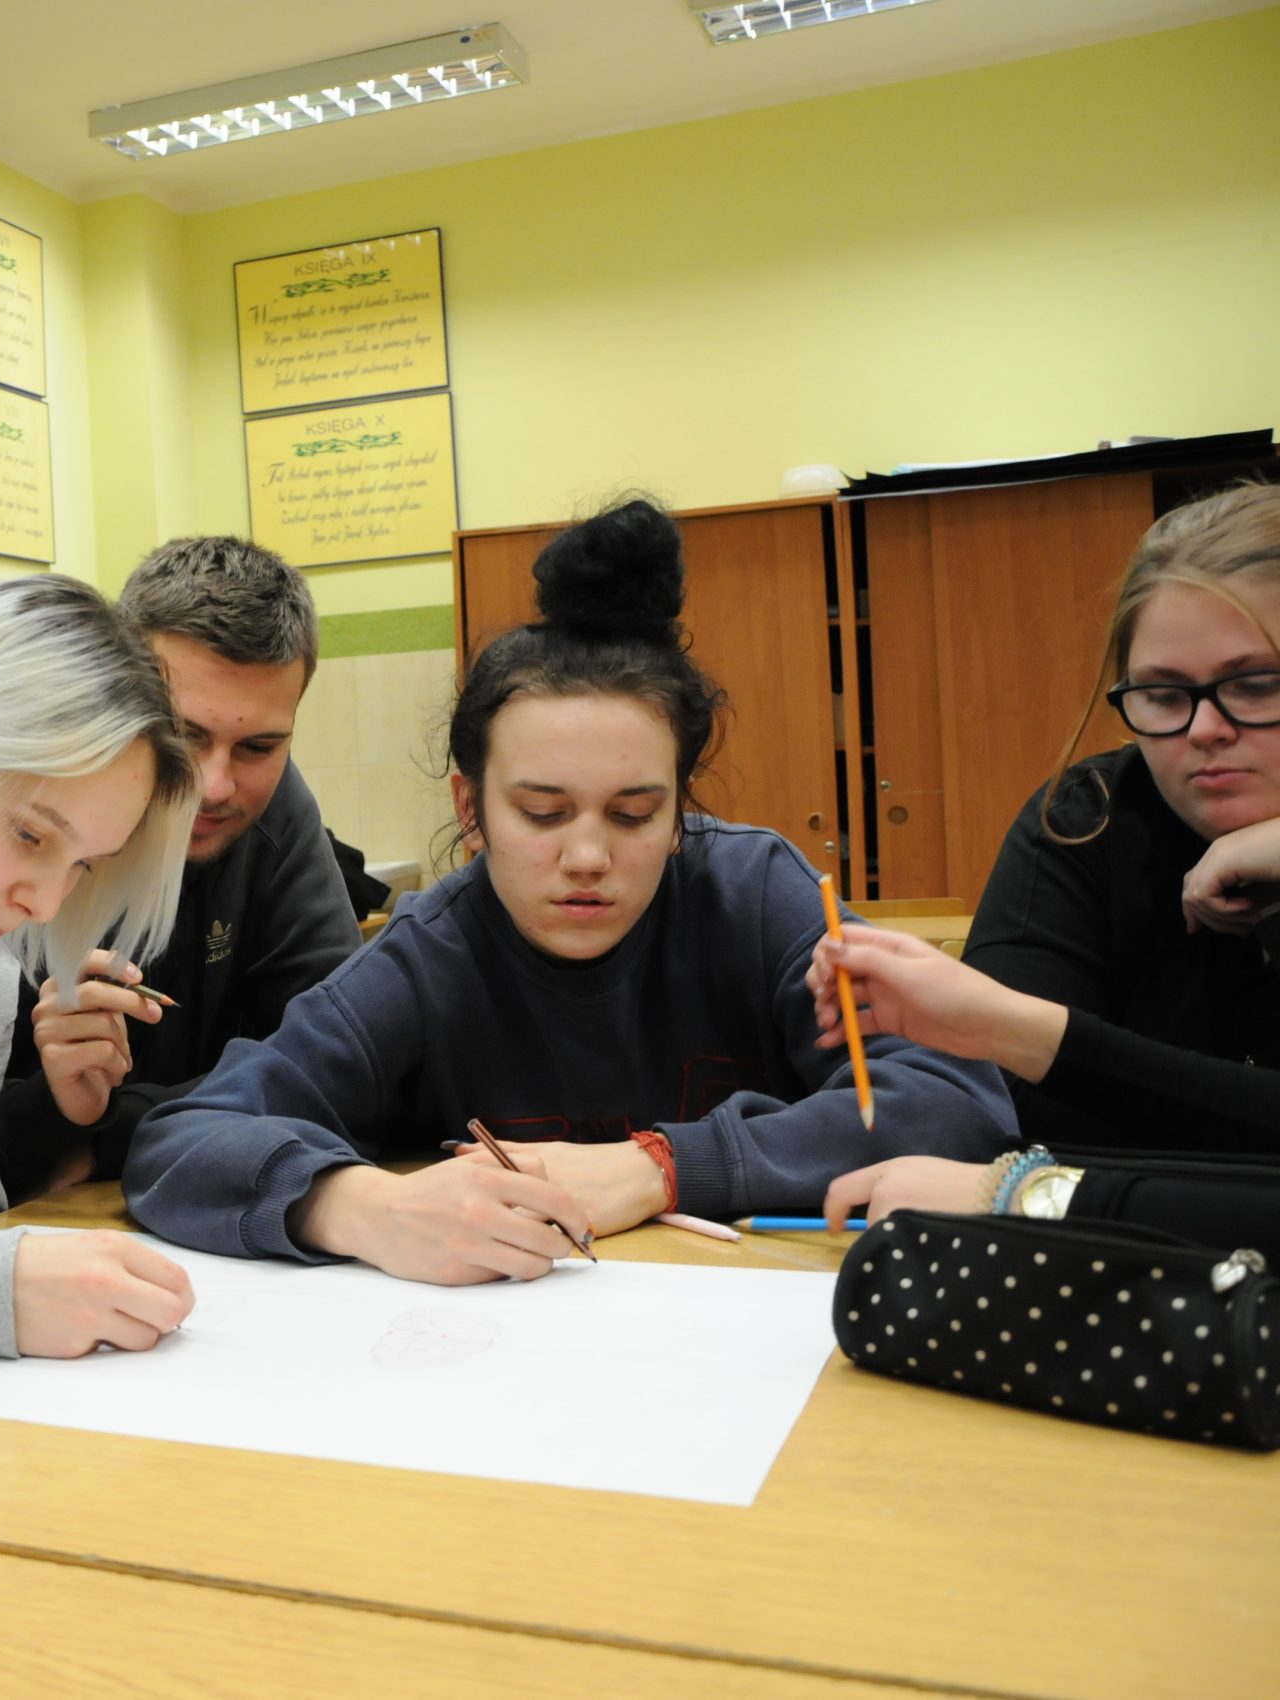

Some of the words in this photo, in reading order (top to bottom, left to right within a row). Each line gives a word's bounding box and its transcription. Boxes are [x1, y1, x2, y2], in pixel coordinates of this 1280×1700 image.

[294, 257, 354, 277] KSIĘGA
[361, 252, 377, 265] IX
[305, 416, 367, 437] KSIĘGA
[375, 413, 386, 427] X
